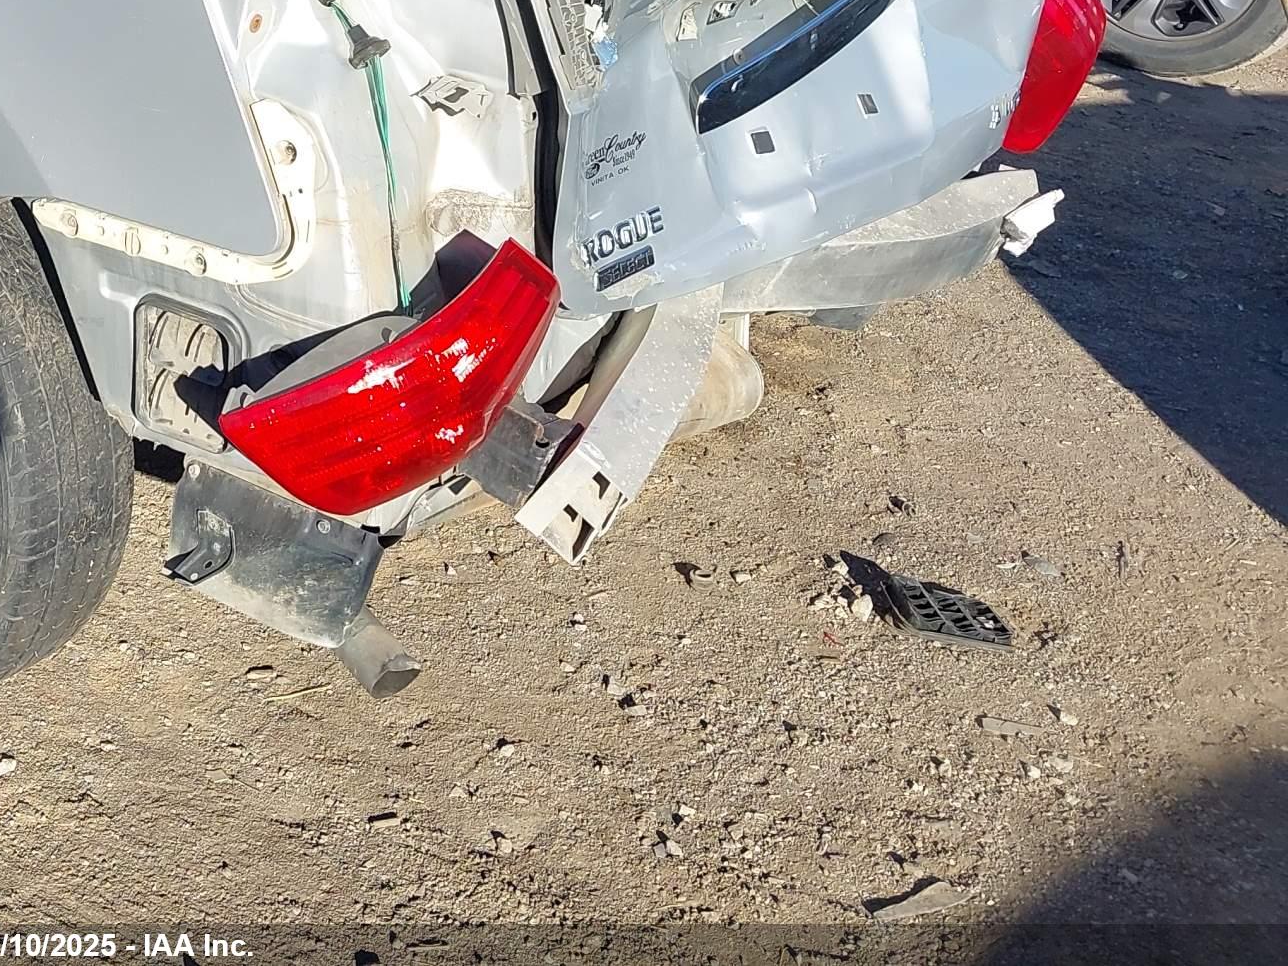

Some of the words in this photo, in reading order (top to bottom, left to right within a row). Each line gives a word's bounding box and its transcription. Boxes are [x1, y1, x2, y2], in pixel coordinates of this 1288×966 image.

[583, 144, 605, 166] reen
[604, 131, 647, 164] Country
[591, 172, 614, 187] VINITA
[617, 165, 629, 175] OK
[581, 206, 665, 266] ROGUE
[600, 249, 652, 288] SELECT
